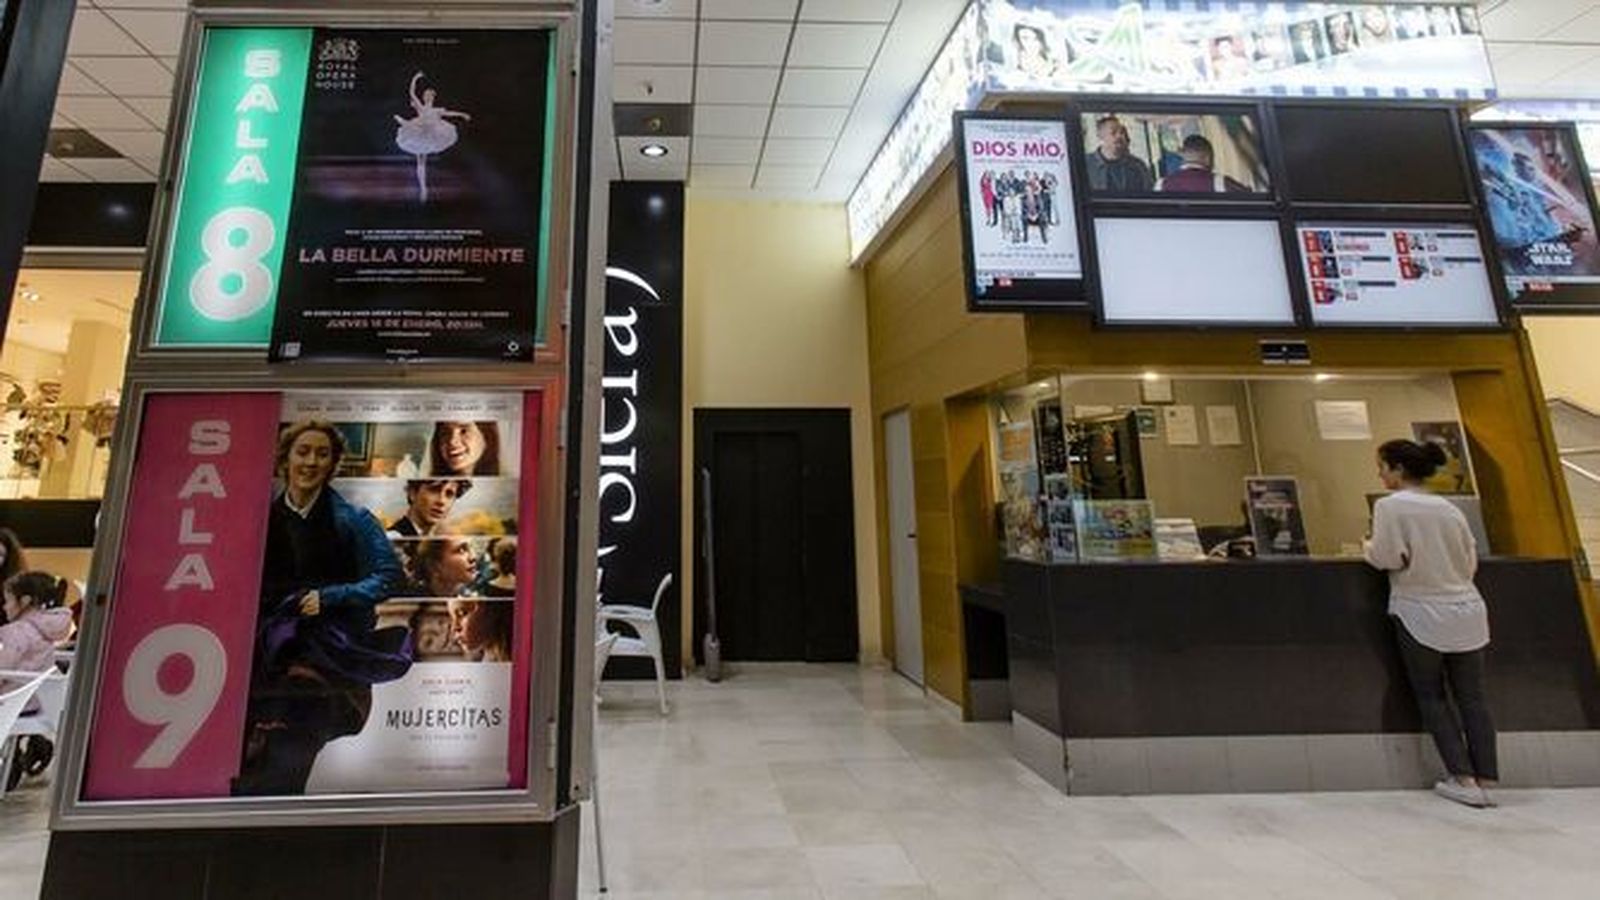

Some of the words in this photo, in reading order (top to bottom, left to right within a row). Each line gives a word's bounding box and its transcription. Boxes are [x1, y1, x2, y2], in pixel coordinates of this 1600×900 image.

[226, 49, 282, 184] SALA
[972, 140, 1018, 157] DIOS
[299, 248, 327, 262] LA
[332, 248, 398, 262] BELLA
[402, 248, 525, 263] DURMIENTE
[1524, 242, 1572, 255] STAR
[1530, 254, 1573, 266] WARS
[189, 206, 276, 322] 8
[163, 419, 231, 592] SALA
[122, 623, 228, 769] 9
[385, 706, 502, 730] MUJERCITAS
